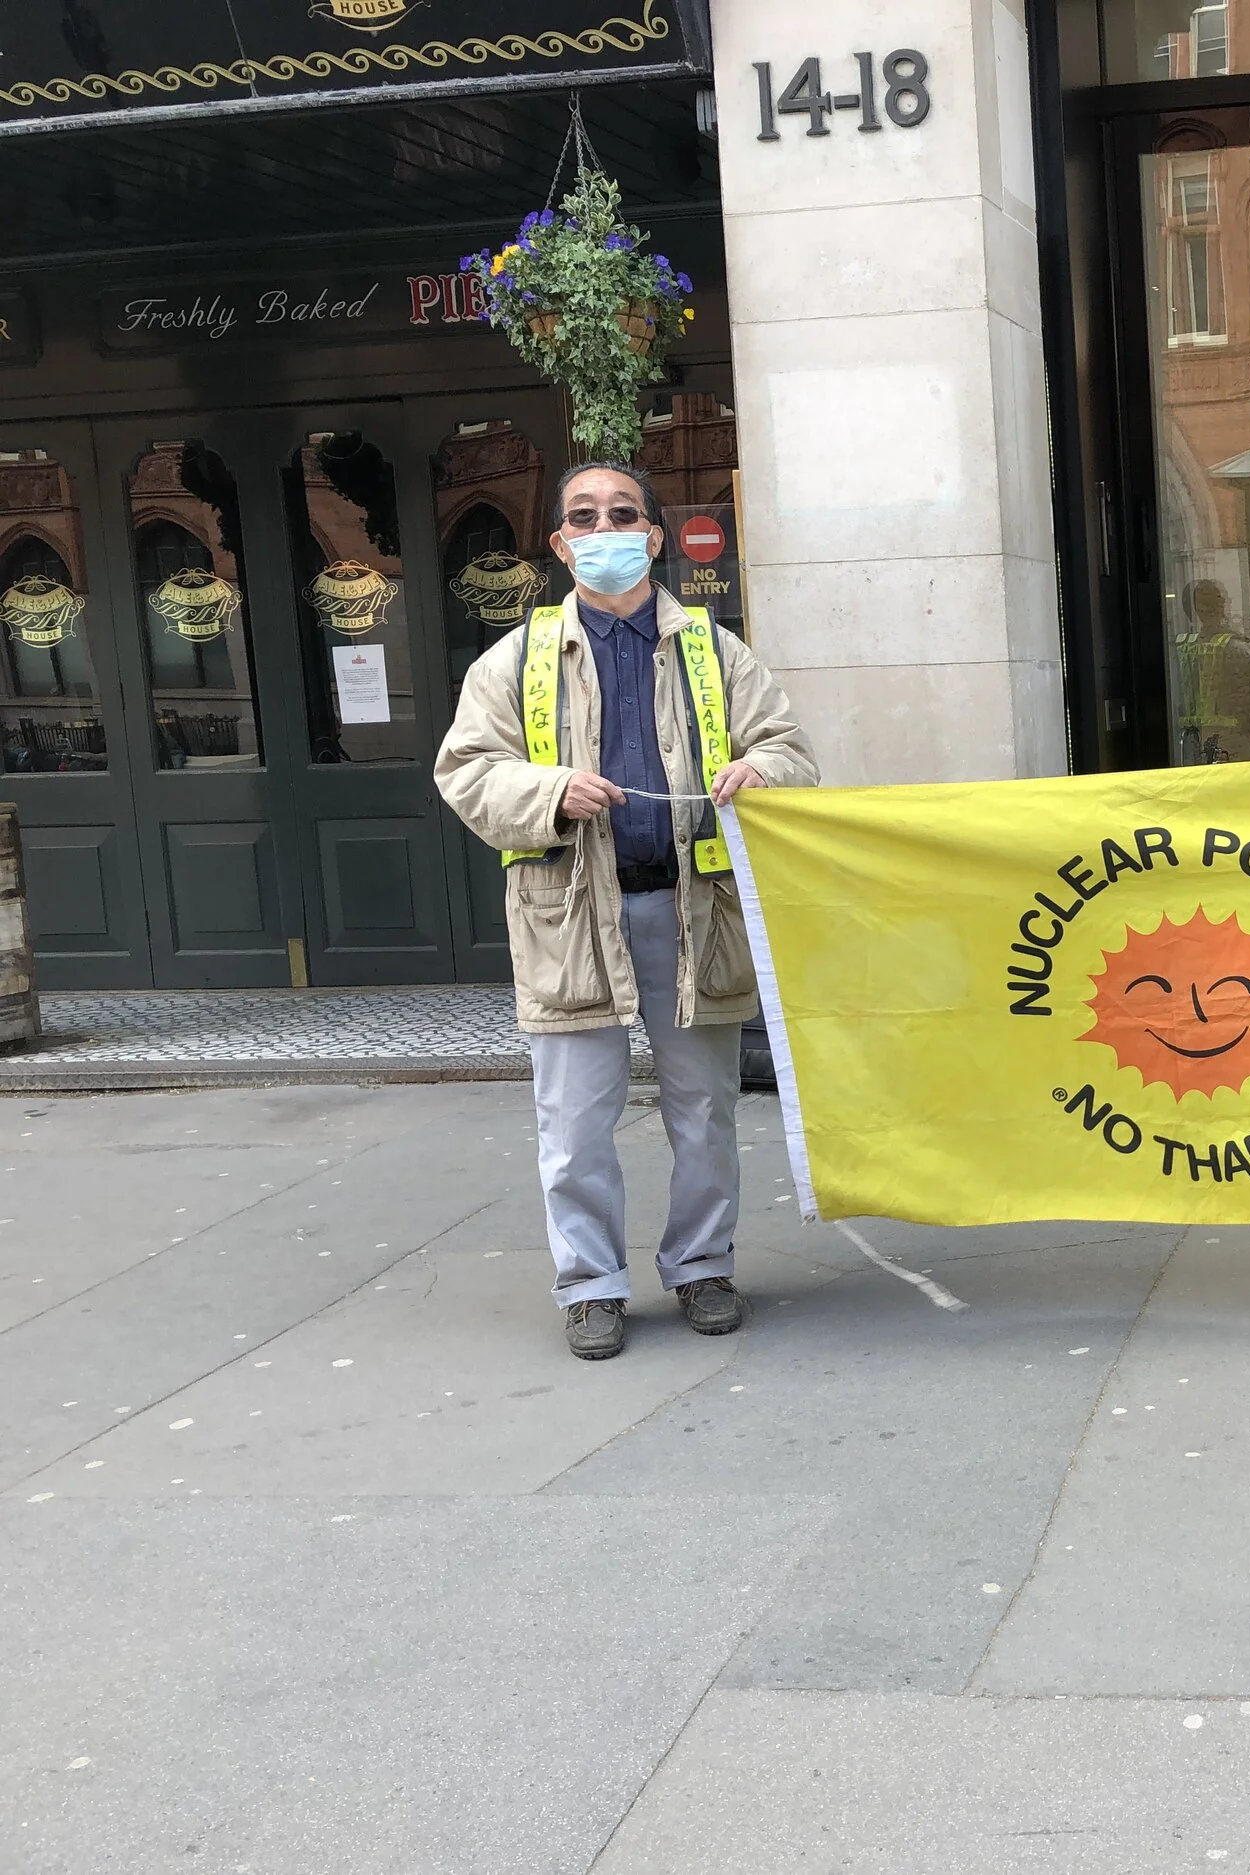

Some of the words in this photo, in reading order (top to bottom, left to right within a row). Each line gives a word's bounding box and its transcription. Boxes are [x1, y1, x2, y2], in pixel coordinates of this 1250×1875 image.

[340, 0, 399, 14] HOUSE
[752, 48, 931, 141] 14-18
[117, 295, 238, 340] Freshly
[255, 282, 380, 325] Baked
[406, 271, 487, 325] PIE
[692, 568, 717, 582] NO
[680, 581, 731, 595] ENTRY
[484, 608, 520, 619] HOUSE
[336, 616, 370, 627] HOUSE
[26, 631, 60, 640] HOUSE
[182, 624, 217, 634] HOUSE
[687, 642, 718, 734] NUCLEAR
[1006, 826, 1180, 1017] NUCLEAR
[1063, 1083, 1143, 1155] NO
